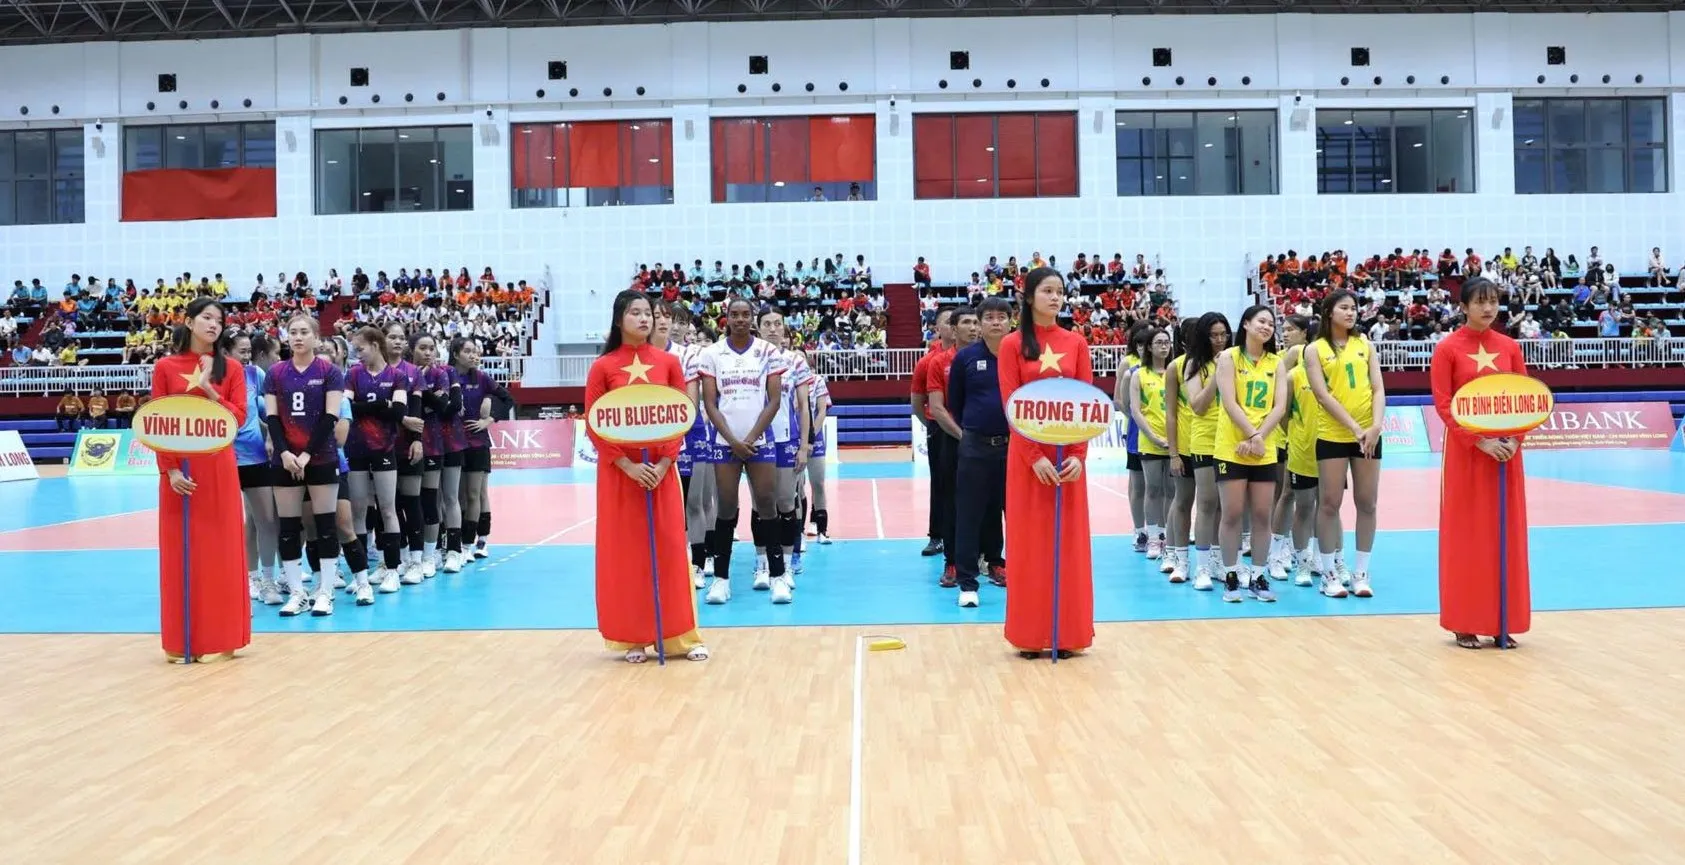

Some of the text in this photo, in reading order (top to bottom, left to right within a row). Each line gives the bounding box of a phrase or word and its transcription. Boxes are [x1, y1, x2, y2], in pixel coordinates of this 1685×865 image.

[1345, 363, 1356, 389] 1
[292, 391, 305, 411] 8
[1245, 380, 1268, 409] 12
[1456, 397, 1471, 416] VTV
[1514, 395, 1535, 414] LONG
[1537, 394, 1549, 413] AN
[596, 403, 688, 428] PFU BLUECATS
[1013, 398, 1110, 425] TRỌNG TÀI
[1534, 410, 1648, 431] IBANK
[143, 412, 227, 438] VĨNH LONG
[3, 451, 31, 466] LONG
[1218, 462, 1228, 475] 12
